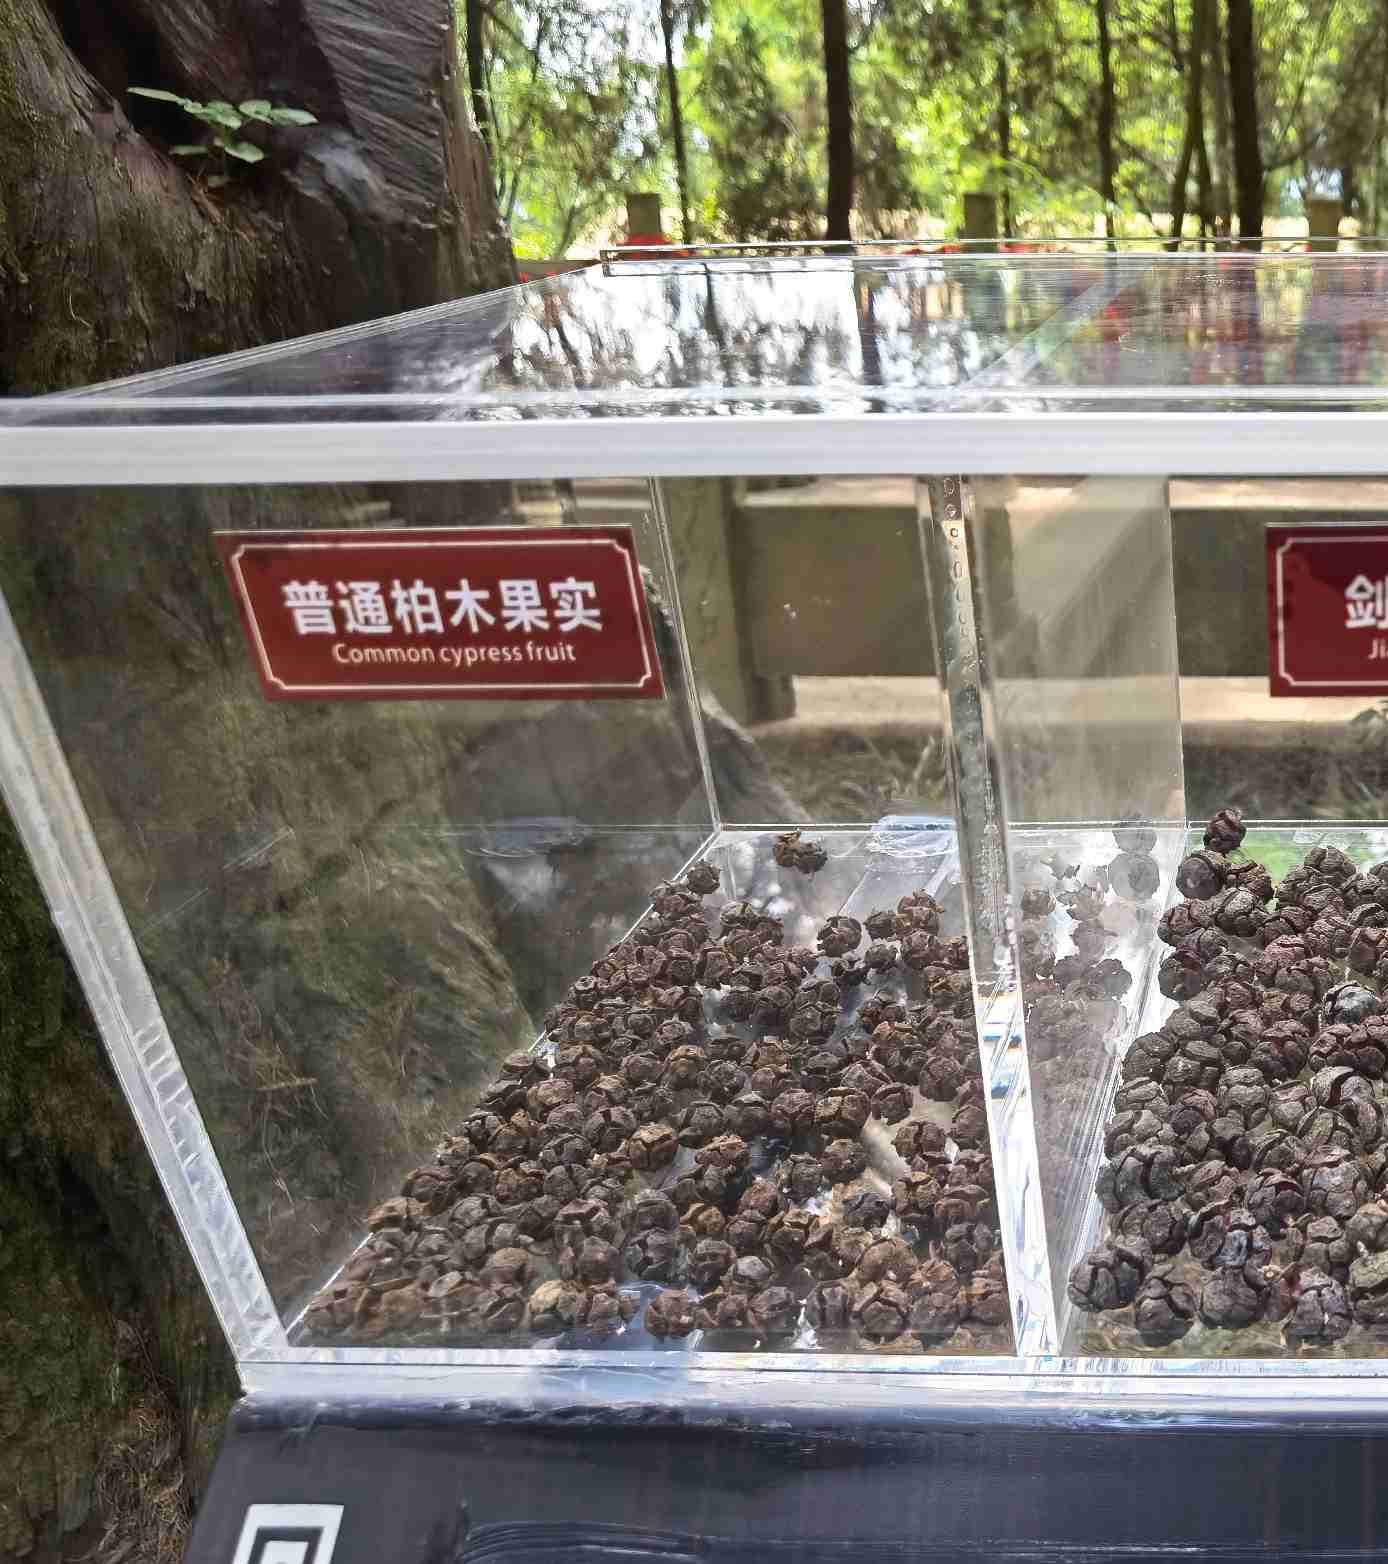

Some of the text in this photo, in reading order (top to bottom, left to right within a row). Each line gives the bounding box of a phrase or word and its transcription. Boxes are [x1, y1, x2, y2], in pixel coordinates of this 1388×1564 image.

[281, 577, 604, 635] 普通柏木果实
[332, 640, 577, 668] Common cypress fruit
